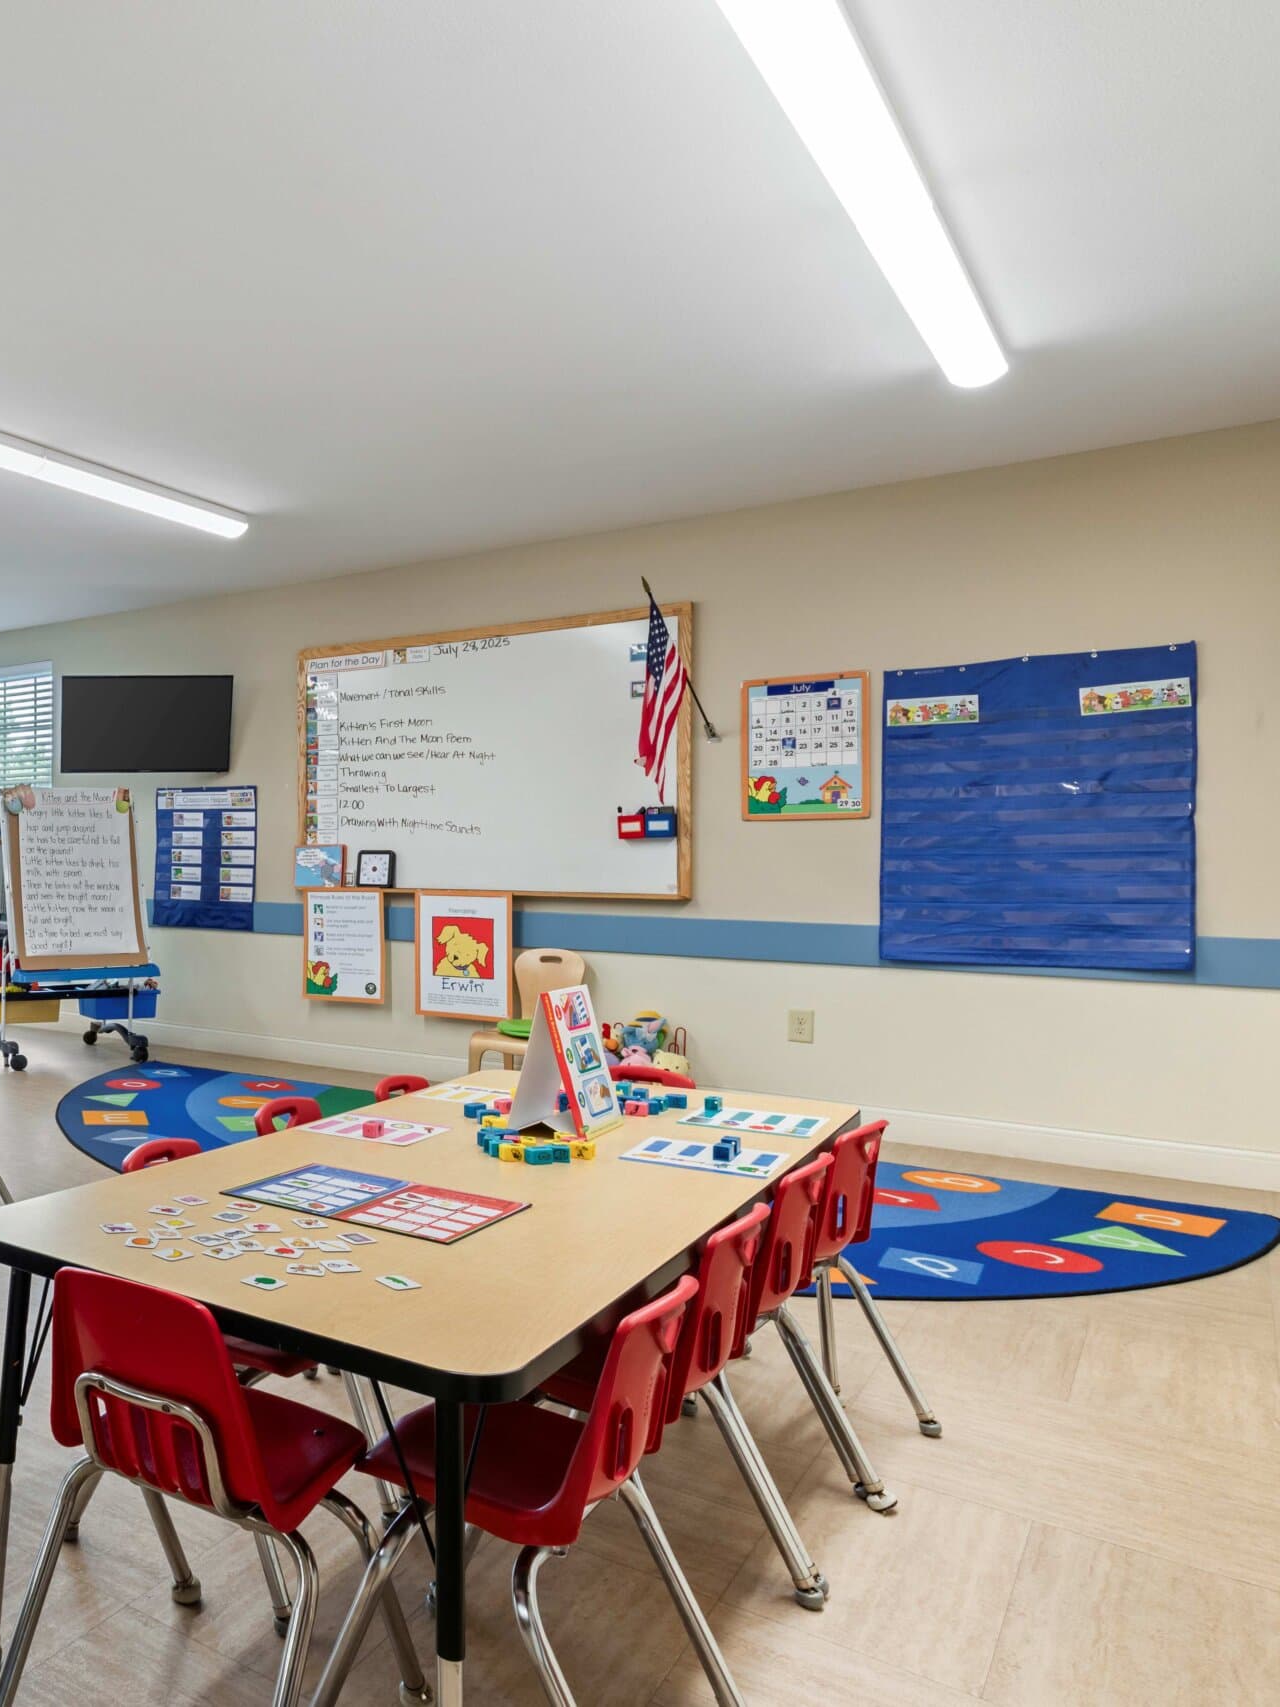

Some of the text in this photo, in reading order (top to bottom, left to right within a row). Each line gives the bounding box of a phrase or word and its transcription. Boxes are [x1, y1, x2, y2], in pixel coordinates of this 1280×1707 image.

[433, 644, 458, 659] July
[480, 638, 510, 650] 2025
[310, 656, 380, 669] Plan for the Day
[790, 684, 811, 693] July
[340, 692, 380, 704] Movement
[380, 718, 404, 728] First
[408, 718, 433, 727] Moon
[340, 736, 372, 746] Kitten
[375, 735, 396, 746] And
[398, 734, 418, 744] The
[420, 734, 443, 744] Moon
[446, 732, 472, 744] Poem
[339, 752, 361, 763] What
[375, 752, 392, 761] can
[340, 768, 387, 784] Throwing
[340, 782, 436, 798] Smallest To Largest
[341, 817, 376, 832] Drawing
[377, 818, 398, 828] With
[445, 821, 481, 835] Sounds
[442, 977, 484, 992] Erwin
